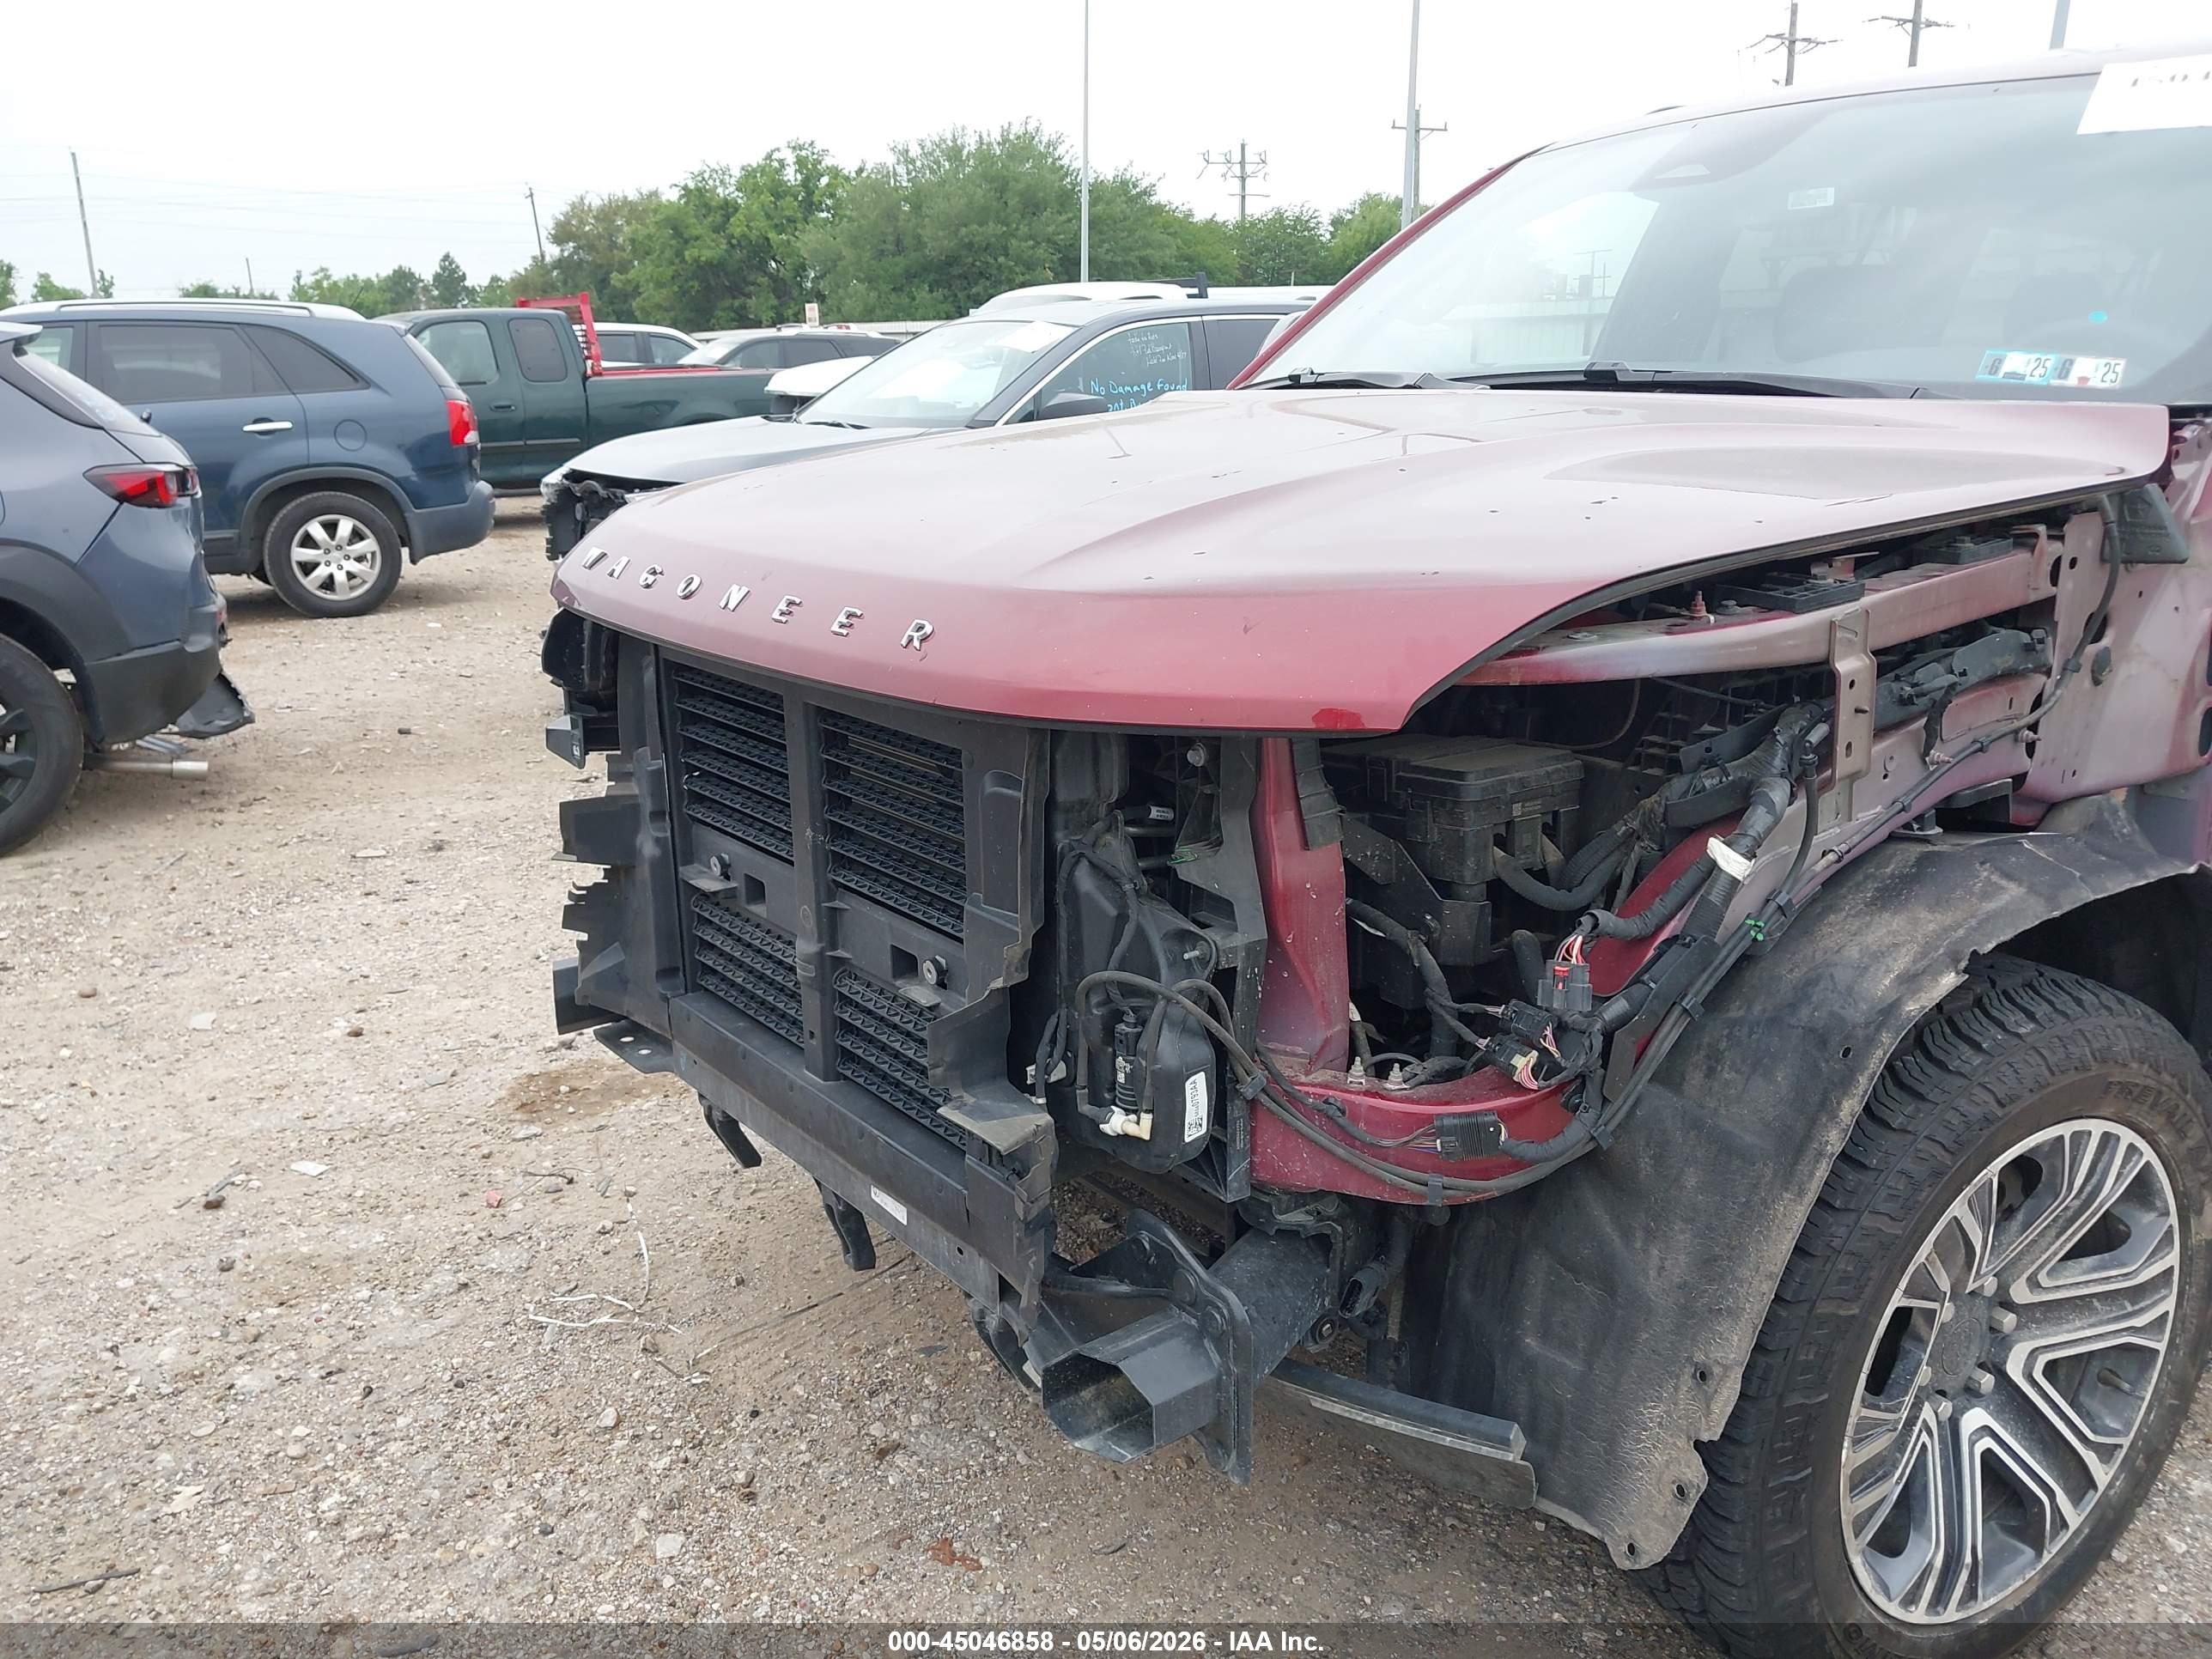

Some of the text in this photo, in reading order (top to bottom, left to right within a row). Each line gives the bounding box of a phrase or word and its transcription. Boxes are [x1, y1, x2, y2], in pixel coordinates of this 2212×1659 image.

[2029, 357, 2051, 378] 25
[2100, 362, 2121, 383] 25
[1091, 378, 1105, 395] No
[1109, 380, 1153, 397] Damage
[581, 546, 935, 652] WAGONEER
